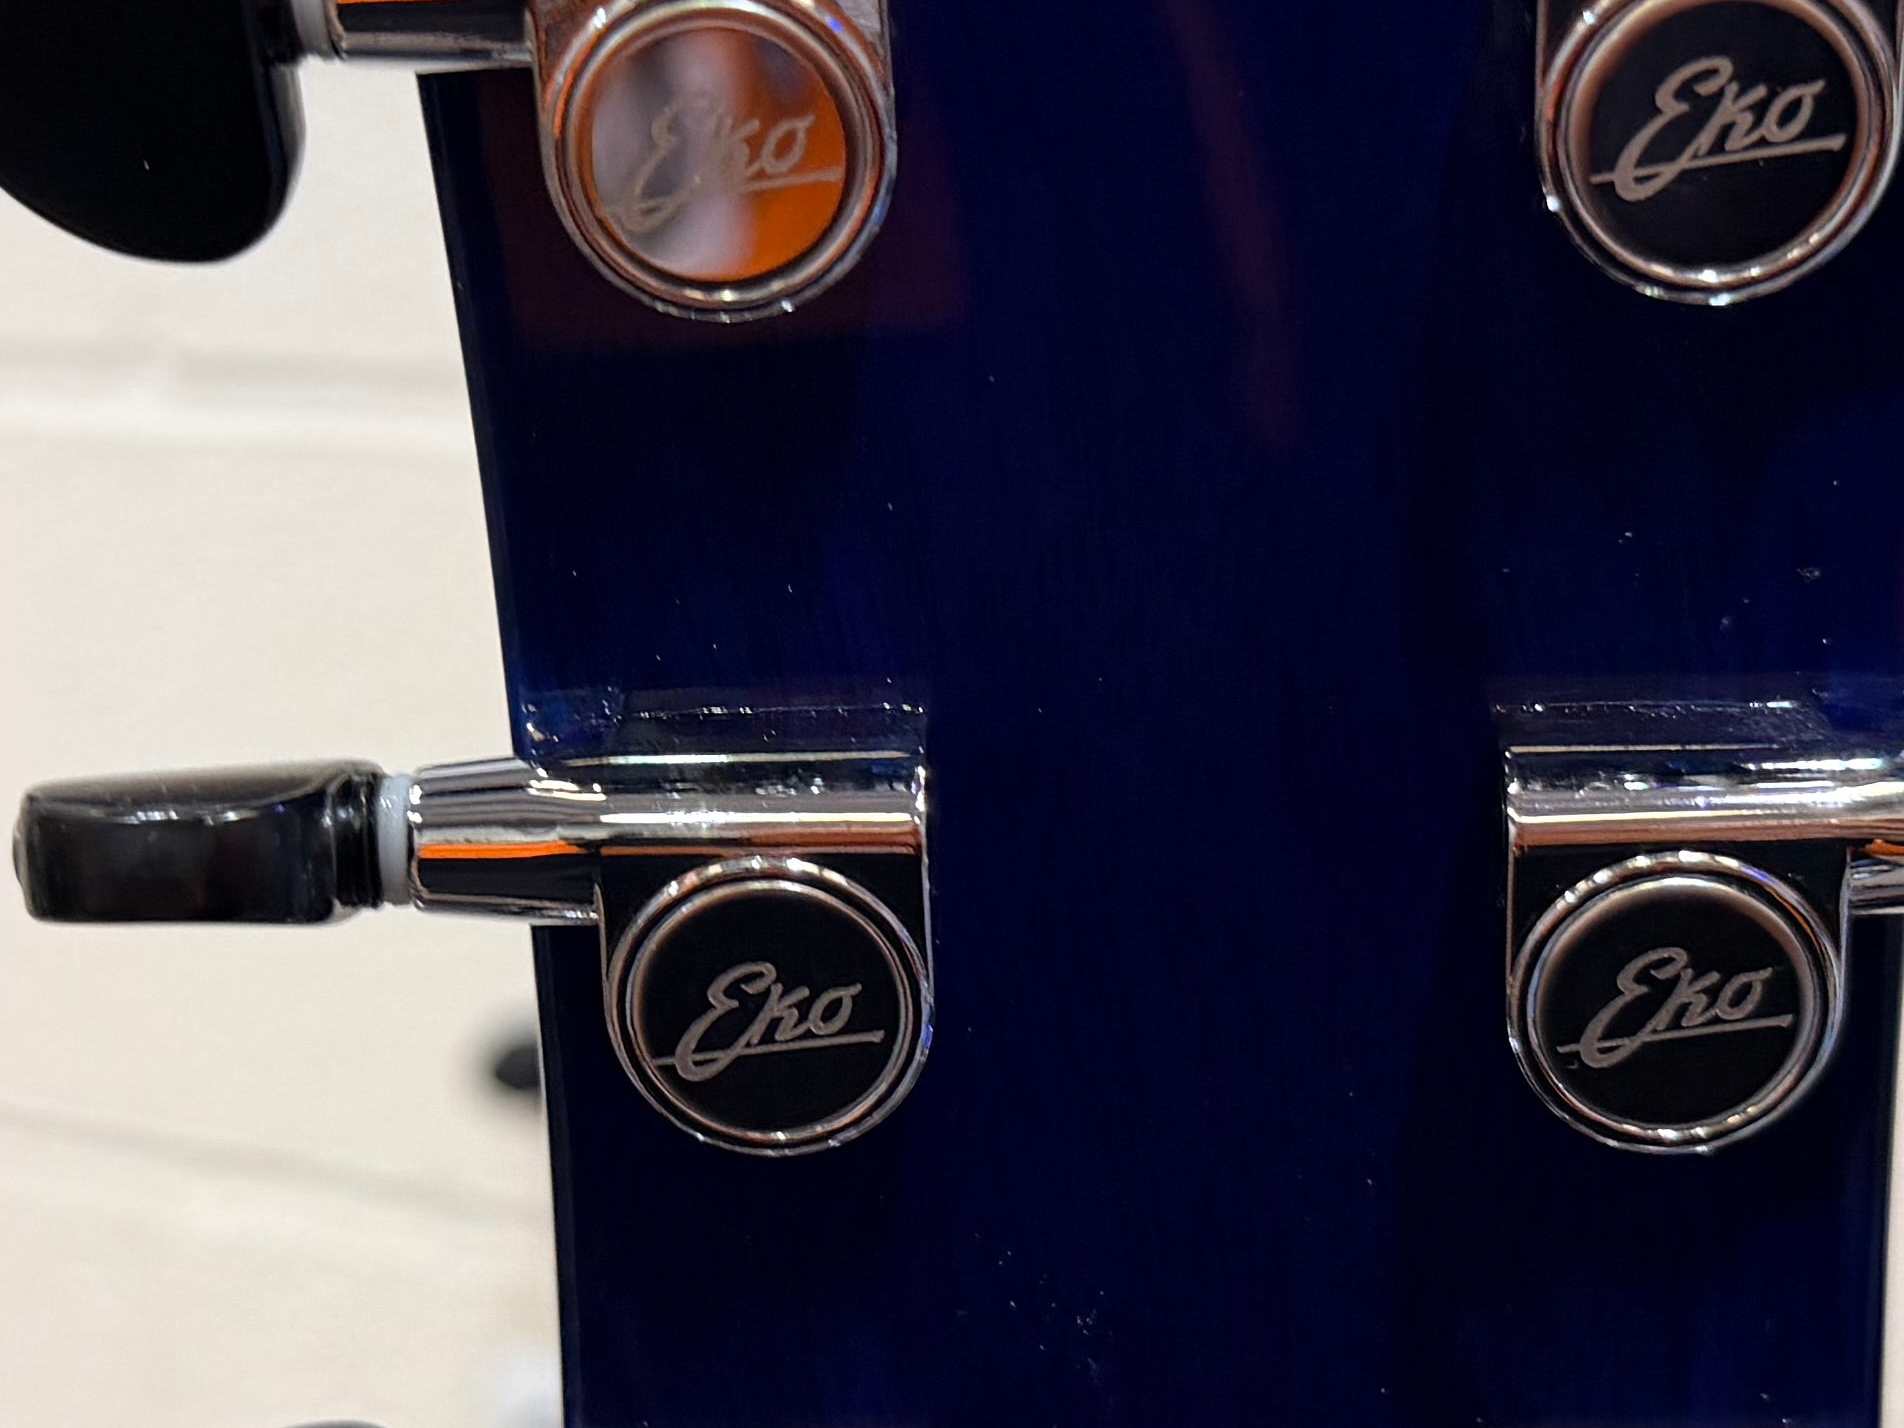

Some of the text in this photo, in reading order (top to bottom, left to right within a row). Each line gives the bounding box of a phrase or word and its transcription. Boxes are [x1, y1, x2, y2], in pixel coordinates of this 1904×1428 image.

[620, 97, 818, 233] Eko
[1612, 54, 1829, 203] Eko
[672, 961, 862, 1081] Eko
[1577, 947, 1771, 1069] Eko
